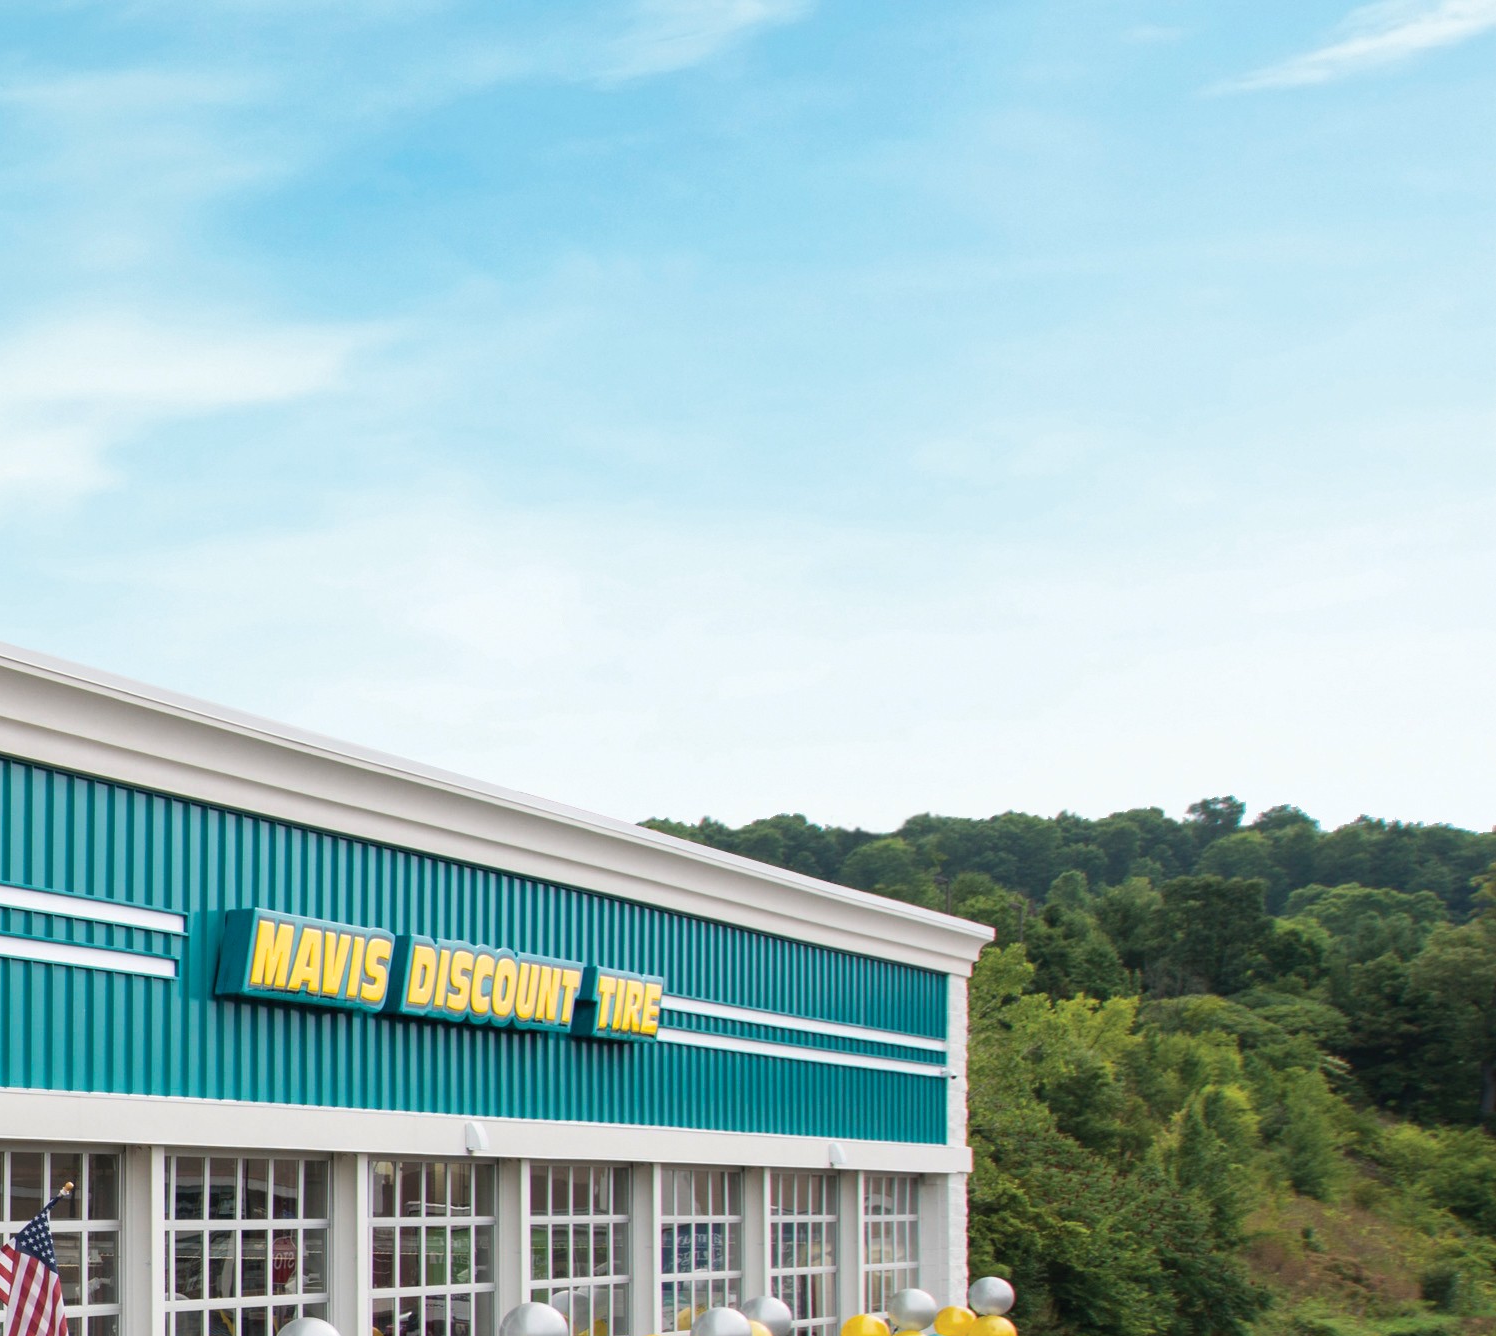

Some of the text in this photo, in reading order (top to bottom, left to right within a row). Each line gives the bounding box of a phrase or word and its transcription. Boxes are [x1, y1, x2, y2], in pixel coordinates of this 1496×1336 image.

[250, 919, 663, 1035] MAVIS DISCOUNT TIRE
